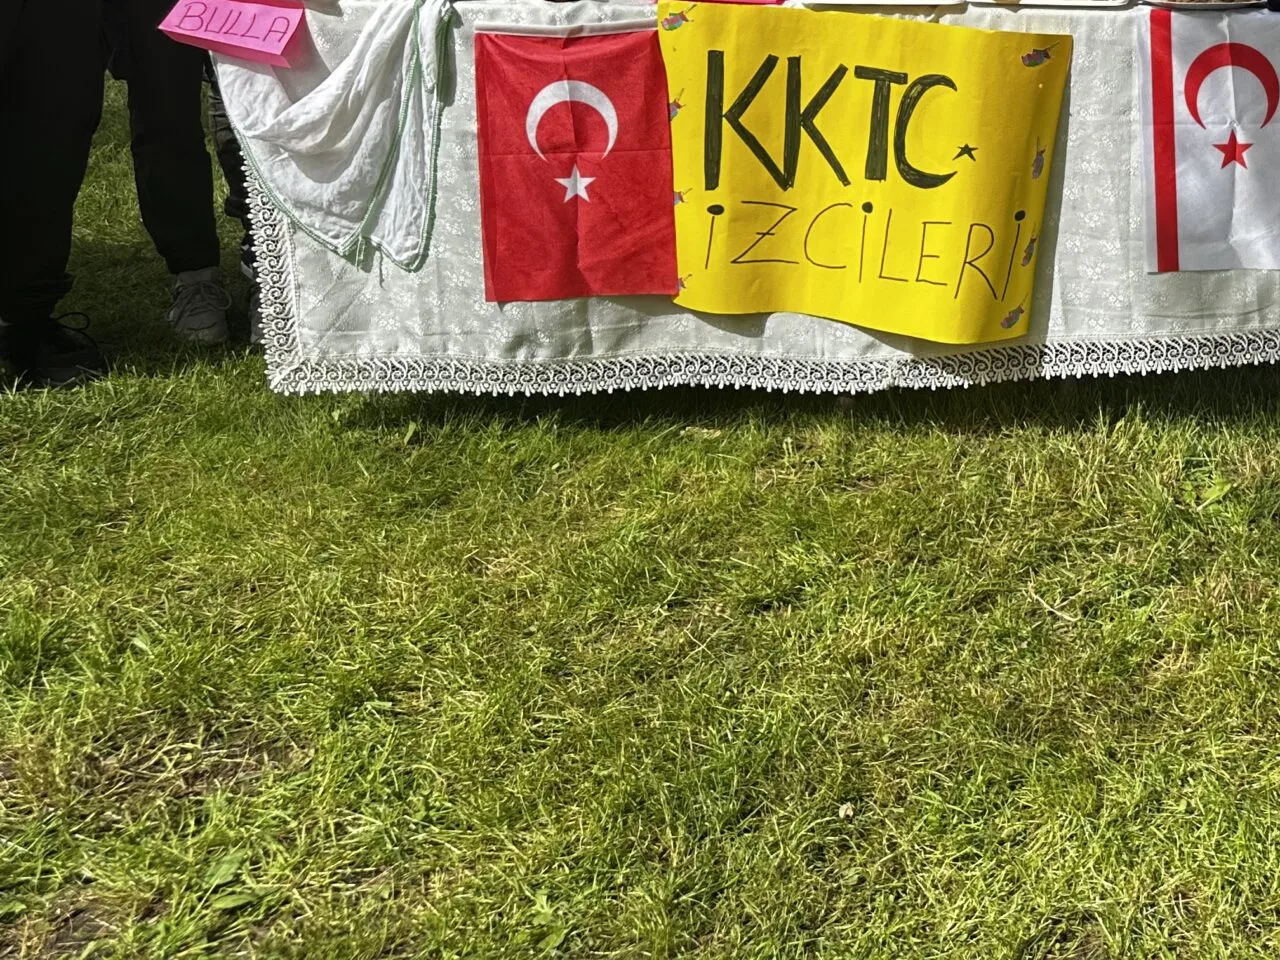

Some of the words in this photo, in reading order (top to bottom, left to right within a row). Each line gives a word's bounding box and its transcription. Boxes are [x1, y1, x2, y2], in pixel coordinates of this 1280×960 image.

[175, 1, 290, 43] BULLA
[704, 49, 958, 192] KKTC
[705, 200, 1027, 301] İZCİLERİ
